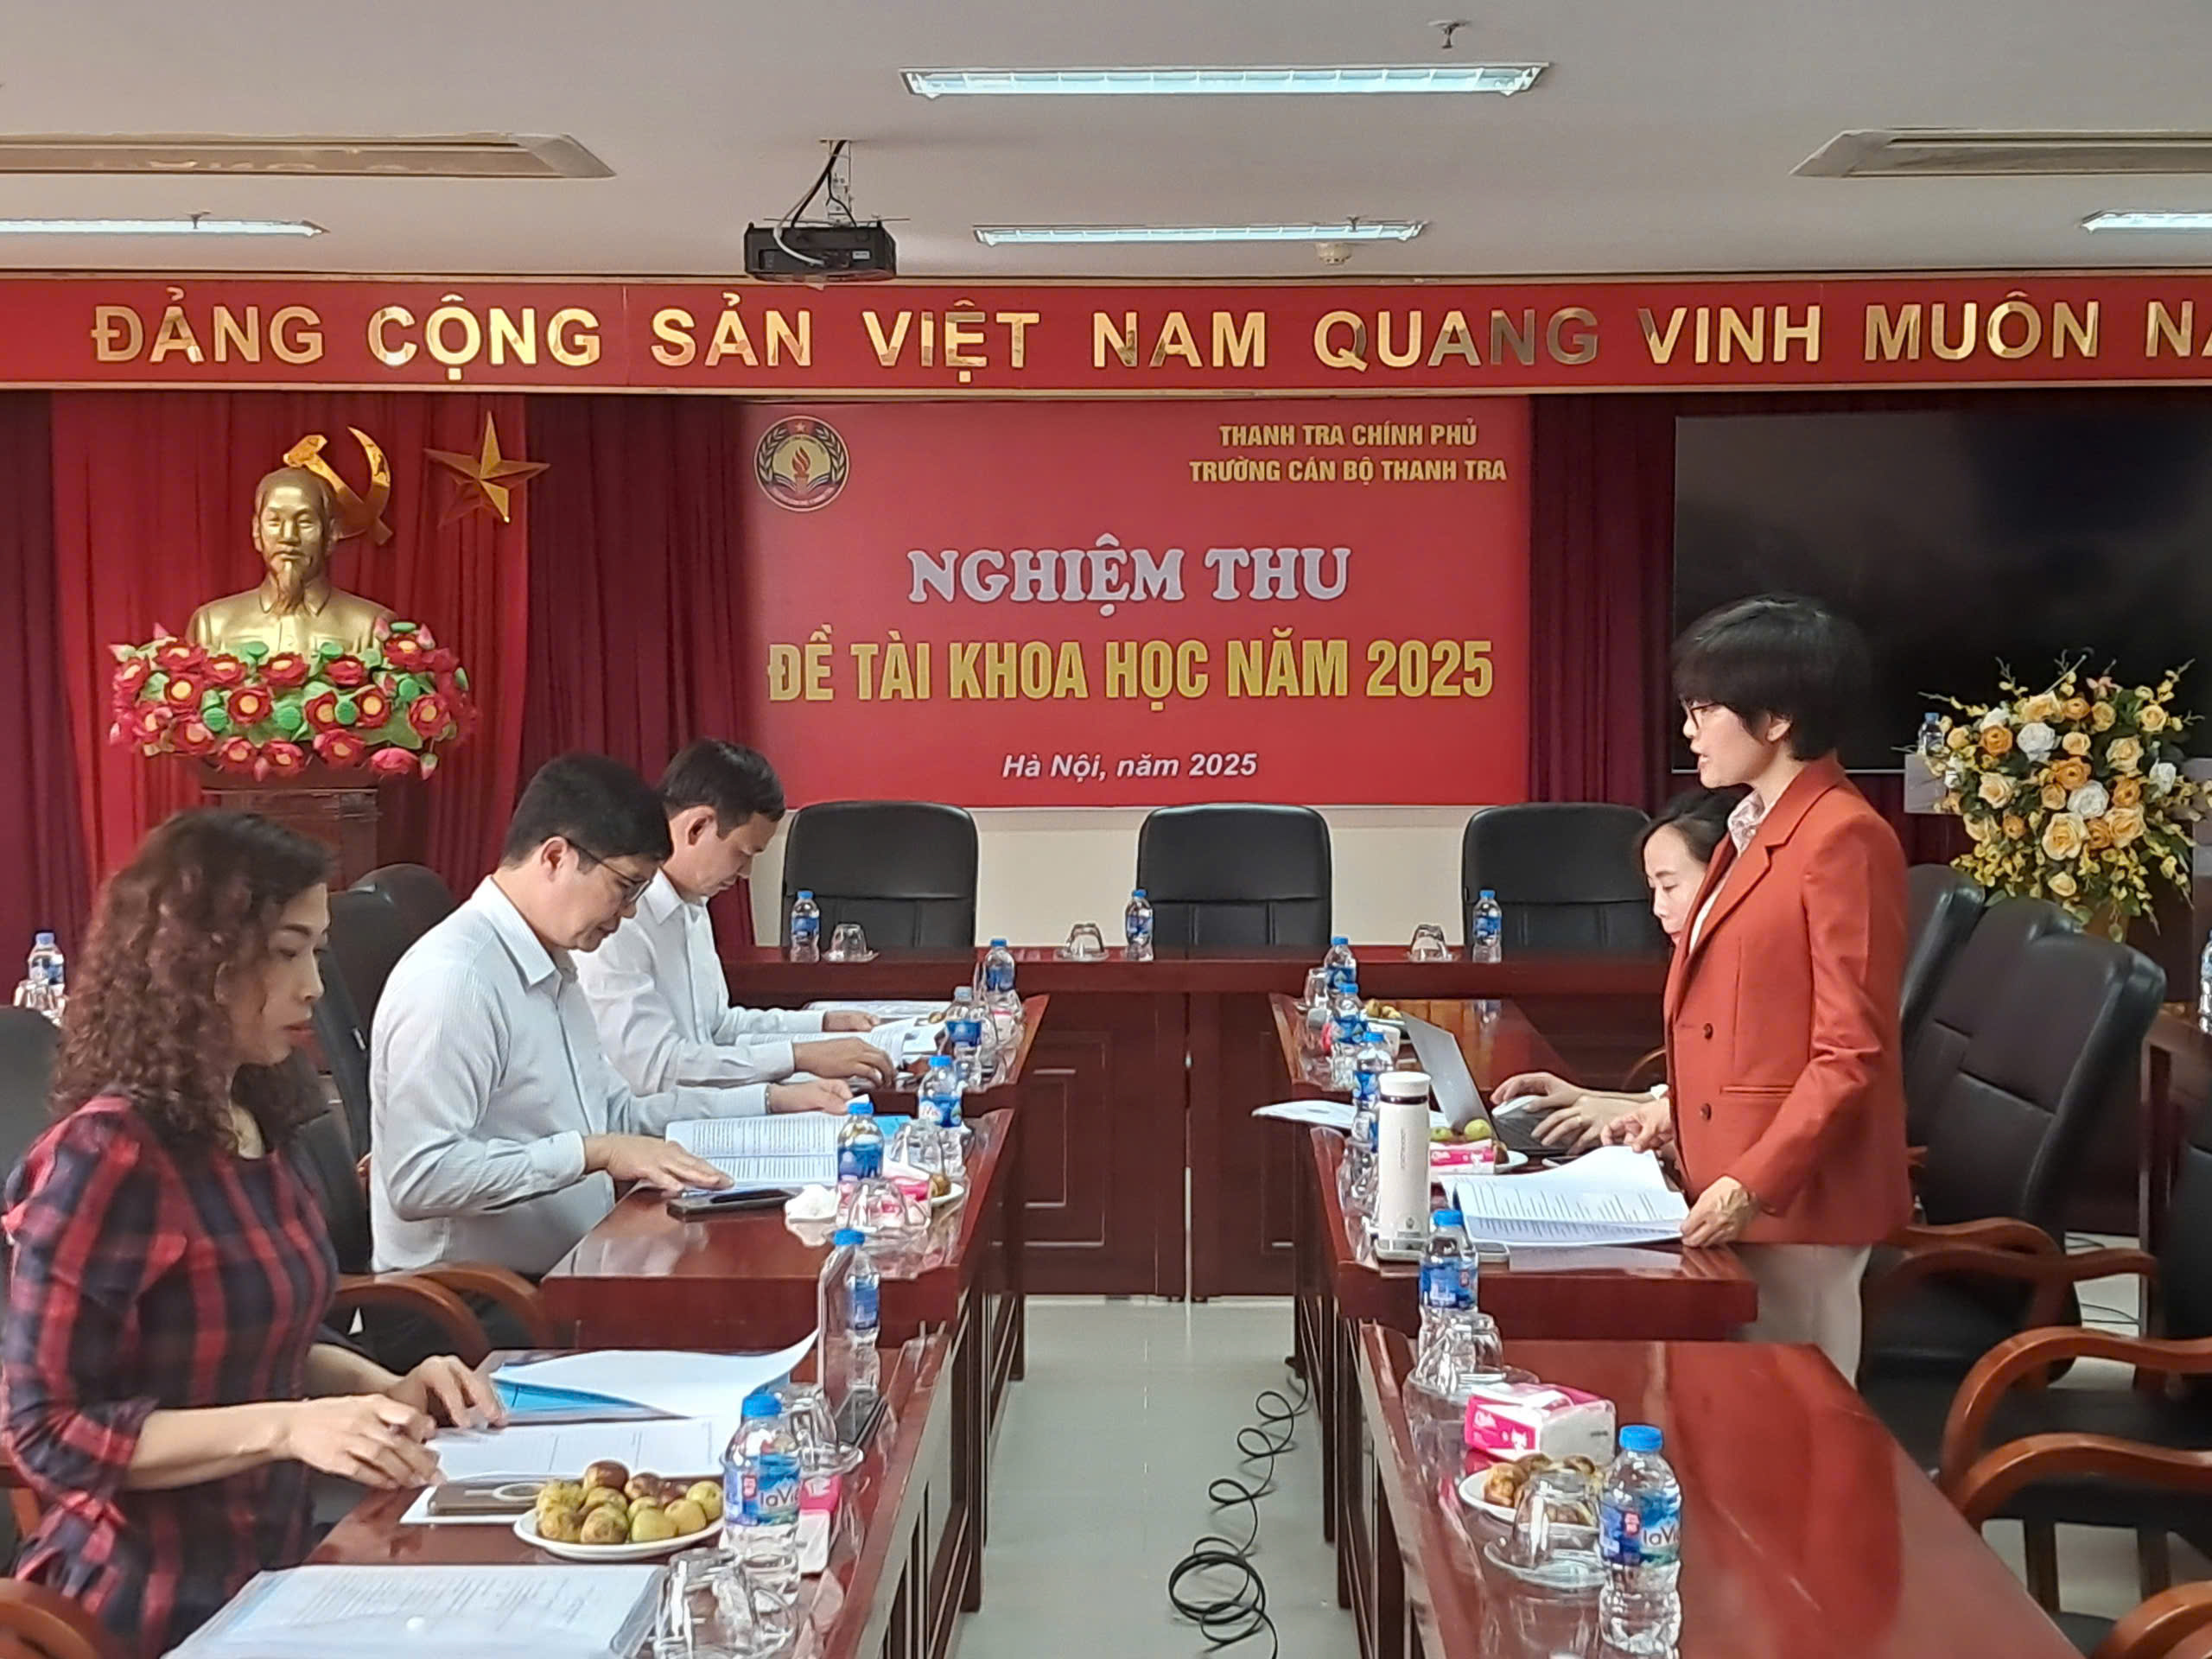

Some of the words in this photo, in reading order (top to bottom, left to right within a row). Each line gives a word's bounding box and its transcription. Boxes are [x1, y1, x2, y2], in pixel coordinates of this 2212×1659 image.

[91, 287, 324, 364] ĐẢNG
[366, 294, 601, 380] CỘNG
[651, 292, 813, 367] SẢN
[862, 299, 1040, 383] VIỆT
[1094, 311, 1267, 368] NAM
[1313, 308, 1599, 372] QUANG
[1637, 305, 1821, 365] VINH
[1864, 290, 2100, 361] MUÔN
[2145, 300, 2212, 359] N
[1218, 424, 1295, 447] THANH
[1302, 424, 1344, 446] TRA
[1351, 420, 1423, 446] CHÍNH
[1430, 417, 1477, 446] PHỦ
[1189, 456, 1281, 482] TRƯỜNG
[1288, 456, 1336, 481] CÁN
[1344, 456, 1374, 486] BỘ
[1381, 460, 1457, 481] THANH
[1464, 460, 1507, 481] TRA
[907, 532, 1185, 616] NGHIỆM
[1204, 547, 1351, 601] THU
[767, 624, 834, 701] ĐỀ
[850, 630, 931, 700] TÀI
[950, 642, 1089, 699] KHOA
[1105, 639, 1209, 711] HỌC
[1227, 626, 1349, 697] NĂM
[1366, 639, 1493, 697] 2025
[1002, 753, 1041, 778] Hà
[1051, 753, 1107, 782] Nội,
[1116, 753, 1179, 777] năm
[1189, 753, 1258, 776] 2025
